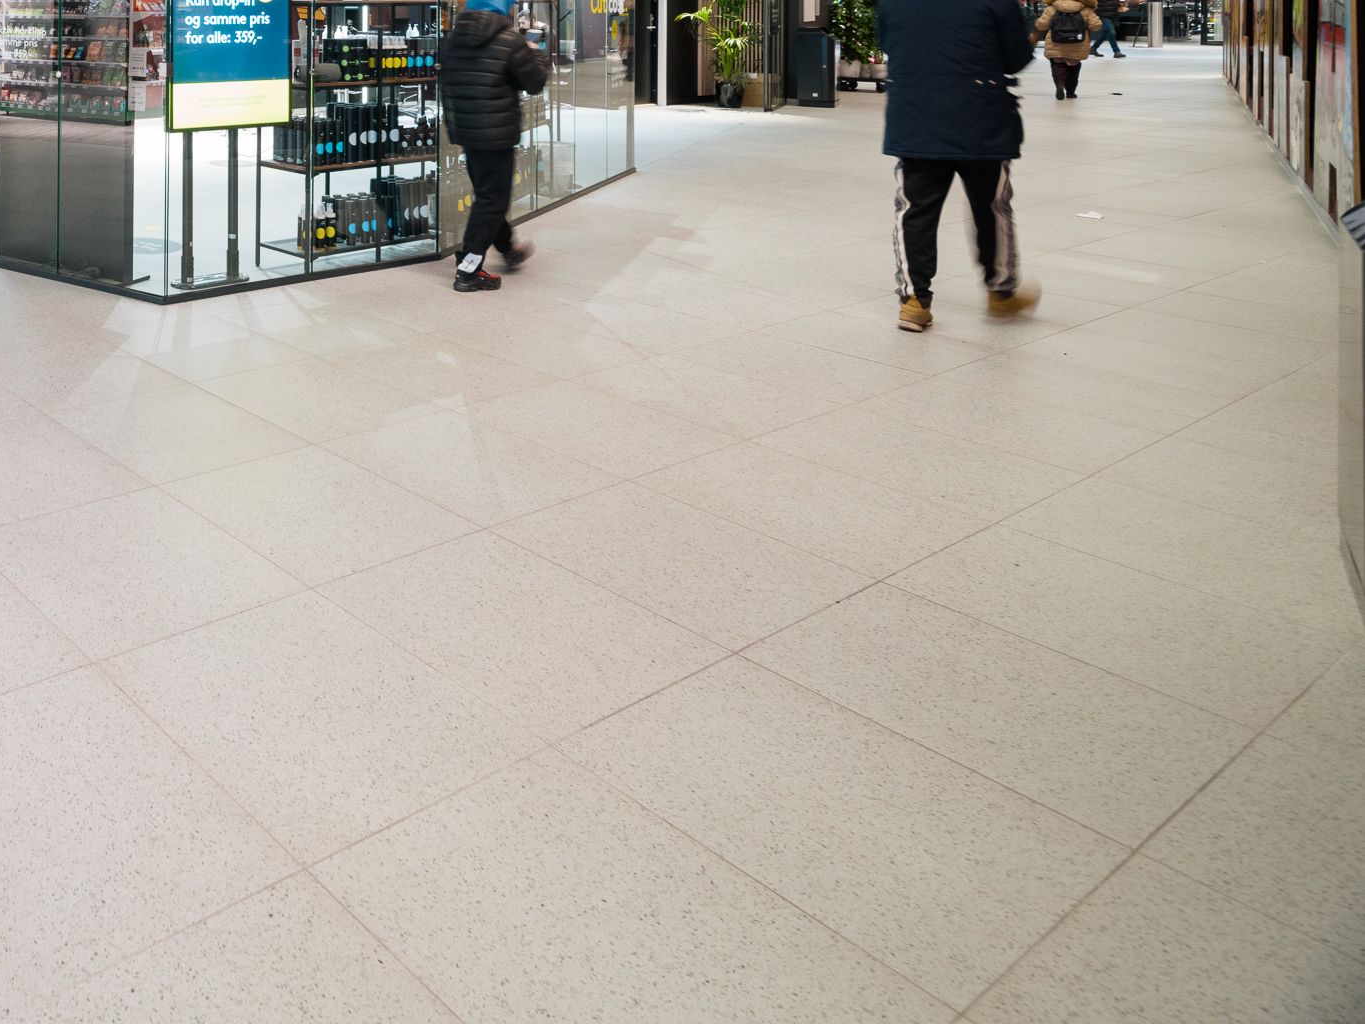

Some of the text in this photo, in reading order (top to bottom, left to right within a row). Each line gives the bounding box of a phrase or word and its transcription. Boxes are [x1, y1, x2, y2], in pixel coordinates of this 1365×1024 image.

[185, 11, 270, 29] og samme pris
[23, 40, 38, 49] pris
[184, 30, 263, 45] for alle: 359,-
